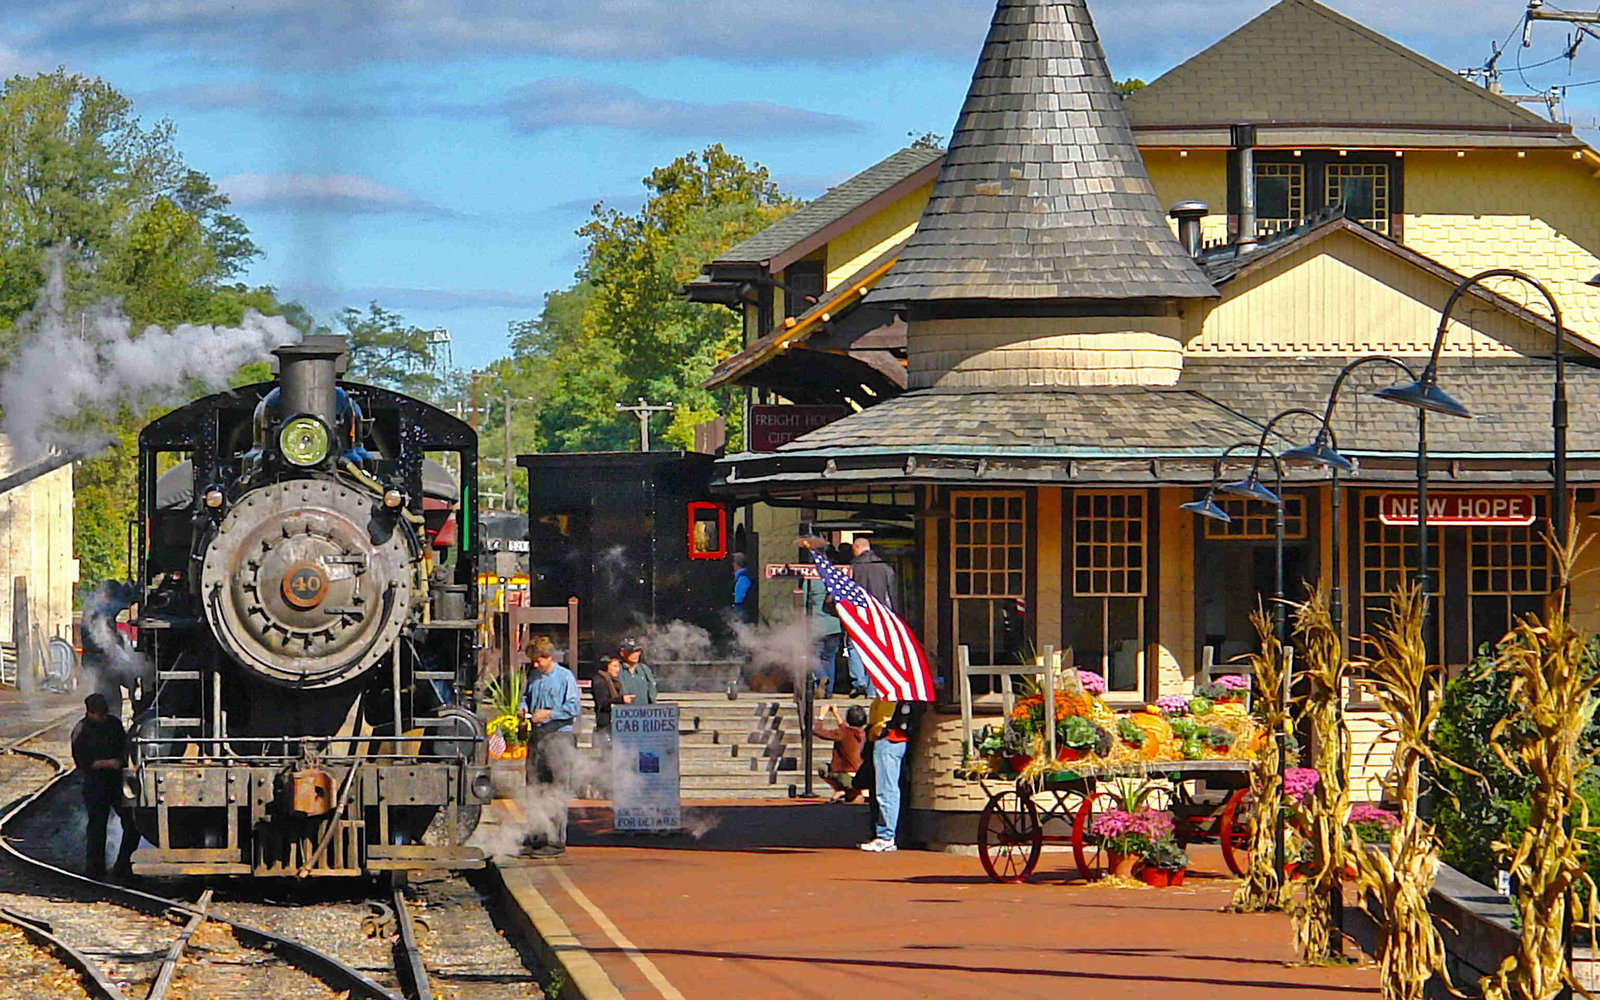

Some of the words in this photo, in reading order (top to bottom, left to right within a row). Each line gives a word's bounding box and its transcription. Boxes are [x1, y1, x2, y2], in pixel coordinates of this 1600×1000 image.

[755, 414, 800, 426] FREIGHT
[768, 432, 792, 444] GIFT
[1391, 498, 1447, 518] NEW
[1457, 498, 1524, 518] HOPE
[769, 567, 788, 576] TO
[291, 576, 321, 592] 40
[615, 707, 675, 719] LOCOMOTIVE
[615, 719, 639, 732] CAB
[642, 718, 675, 732] RIDES
[617, 817, 635, 827] FOR
[638, 816, 678, 827] DETAILS
